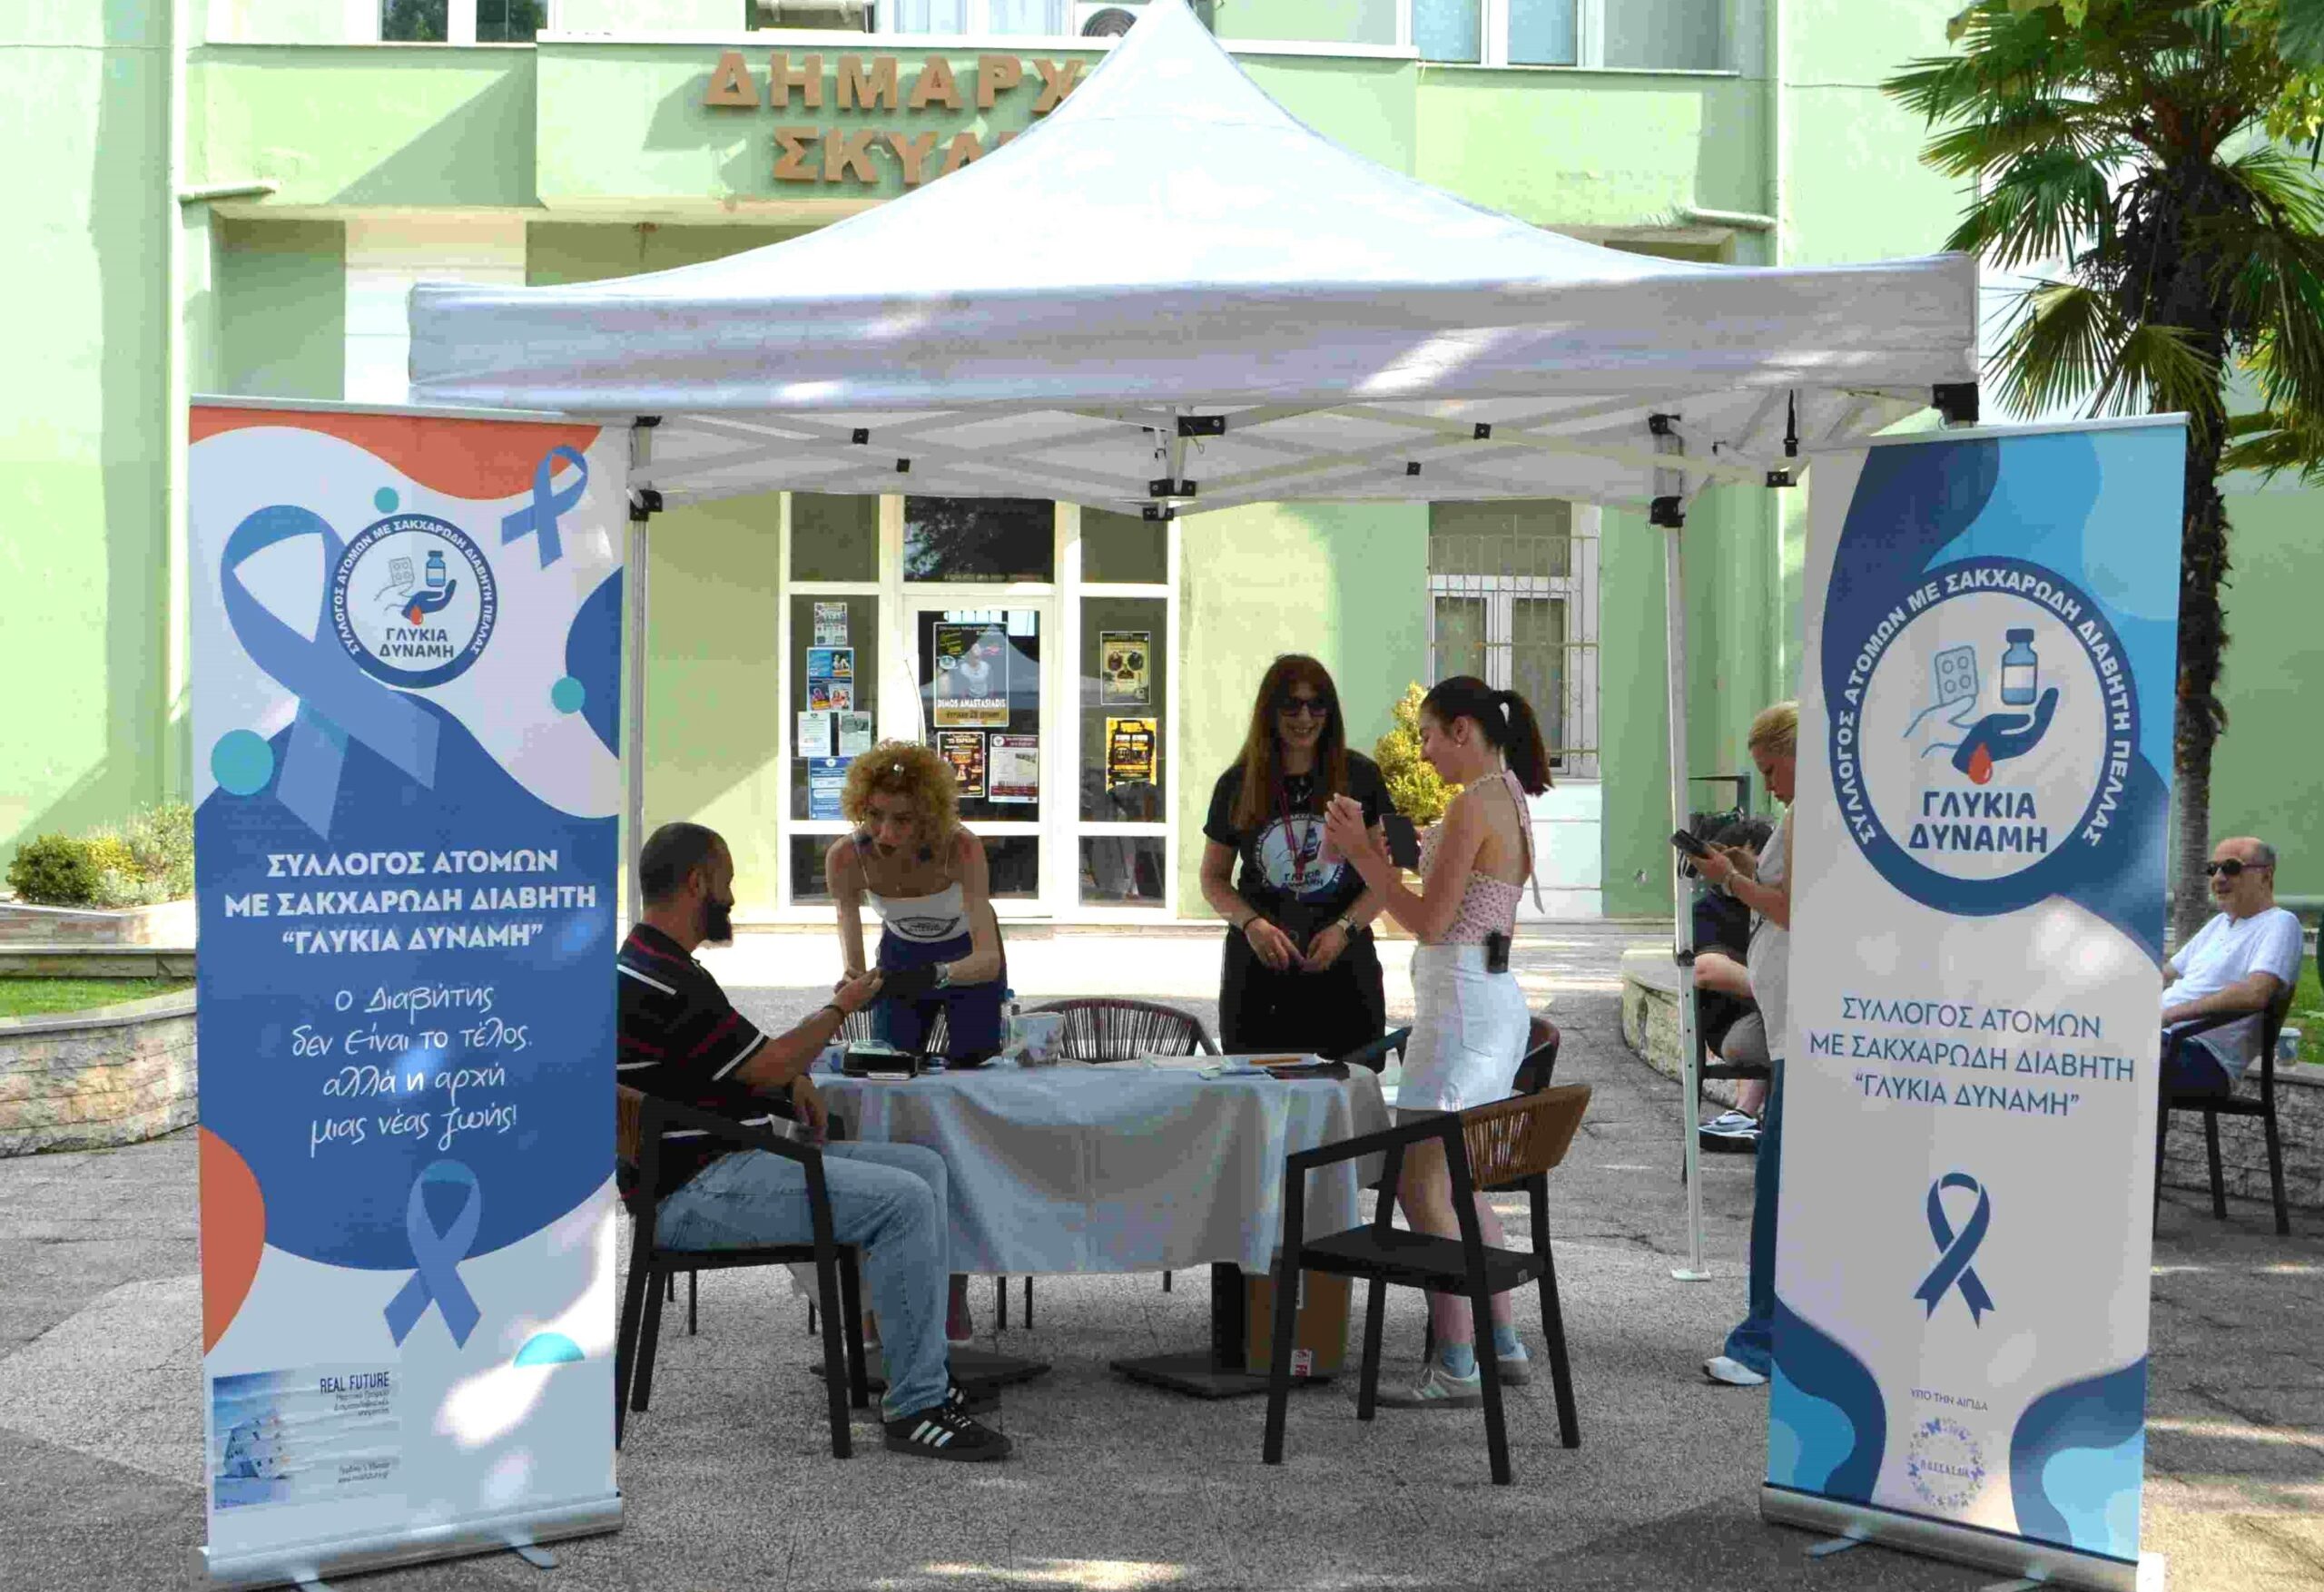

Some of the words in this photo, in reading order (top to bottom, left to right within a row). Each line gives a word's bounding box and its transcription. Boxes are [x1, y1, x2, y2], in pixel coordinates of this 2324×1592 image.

[373, 525, 391, 539] ΜΕ
[394, 520, 466, 548] ΣΑΚΧΑΡΩΔΗ
[338, 536, 373, 584] ΑΤΟΜΩΝ
[465, 545, 493, 601] ΔΙΑΒΗΤΗ
[1907, 581, 1941, 610] ΜΕ
[1945, 568, 2082, 621] ΣΑΚΧΑΡΩΔΗ
[334, 587, 360, 655] ΣΥΛΛΟΓΟΣ
[387, 628, 448, 642] ΓΛΥΚΙΑ
[470, 603, 493, 655] ΠΕΛΛΑΣ
[379, 644, 454, 658] ΔΥΝΑΜΗ
[1843, 607, 1906, 703] ΑΤΟΜΩΝ
[2077, 620, 2131, 730] ΔΙΑΒΗΤΗ
[937, 699, 959, 708] DEMOS
[1837, 710, 1876, 844] ΣΥΛΛΟΓΟΣ
[2083, 741, 2130, 846] ΠΕΛΛΑΣ
[1923, 791, 2036, 820] ΓΛΥΚΙΑ
[1909, 823, 2047, 853] ΔΥΝΑΜΗ
[266, 851, 425, 878] ΣΥΛΛΟΓΟΣ
[432, 850, 558, 874] ΑΤΟΜΩΝ
[224, 893, 270, 918] ΜΕ
[277, 888, 462, 916] ΣΑΚΧΑΡΩΔΗ
[469, 885, 596, 910] ΔΙΑΒΗΤΗ
[364, 984, 494, 1026] Διαβήτης
[1842, 997, 1974, 1028] ΣΥΛΛΟΓΟΣ
[1980, 1008, 2100, 1038] ΑΤΟΜΩΝ
[292, 1024, 333, 1056] δεν
[419, 1030, 448, 1050] το
[1809, 1031, 1844, 1056] ΜΕ
[1852, 1036, 2006, 1070] ΣΑΚΧΑΡΩΔΗ
[2014, 1050, 2134, 1082] ΔΙΑΒΗΤΗ
[322, 1065, 396, 1096] αλλά
[407, 1072, 424, 1091] η
[435, 1062, 506, 1106] αρχή
[310, 1117, 367, 1158] μιας
[378, 1107, 431, 1140] νέας
[438, 1102, 517, 1151] ζωής!
[320, 1376, 345, 1394] REAL
[349, 1371, 389, 1391] FUTURE
[1910, 1388, 1932, 1400] ΥΠΟ
[1934, 1393, 1954, 1404] ΤΗΝ
